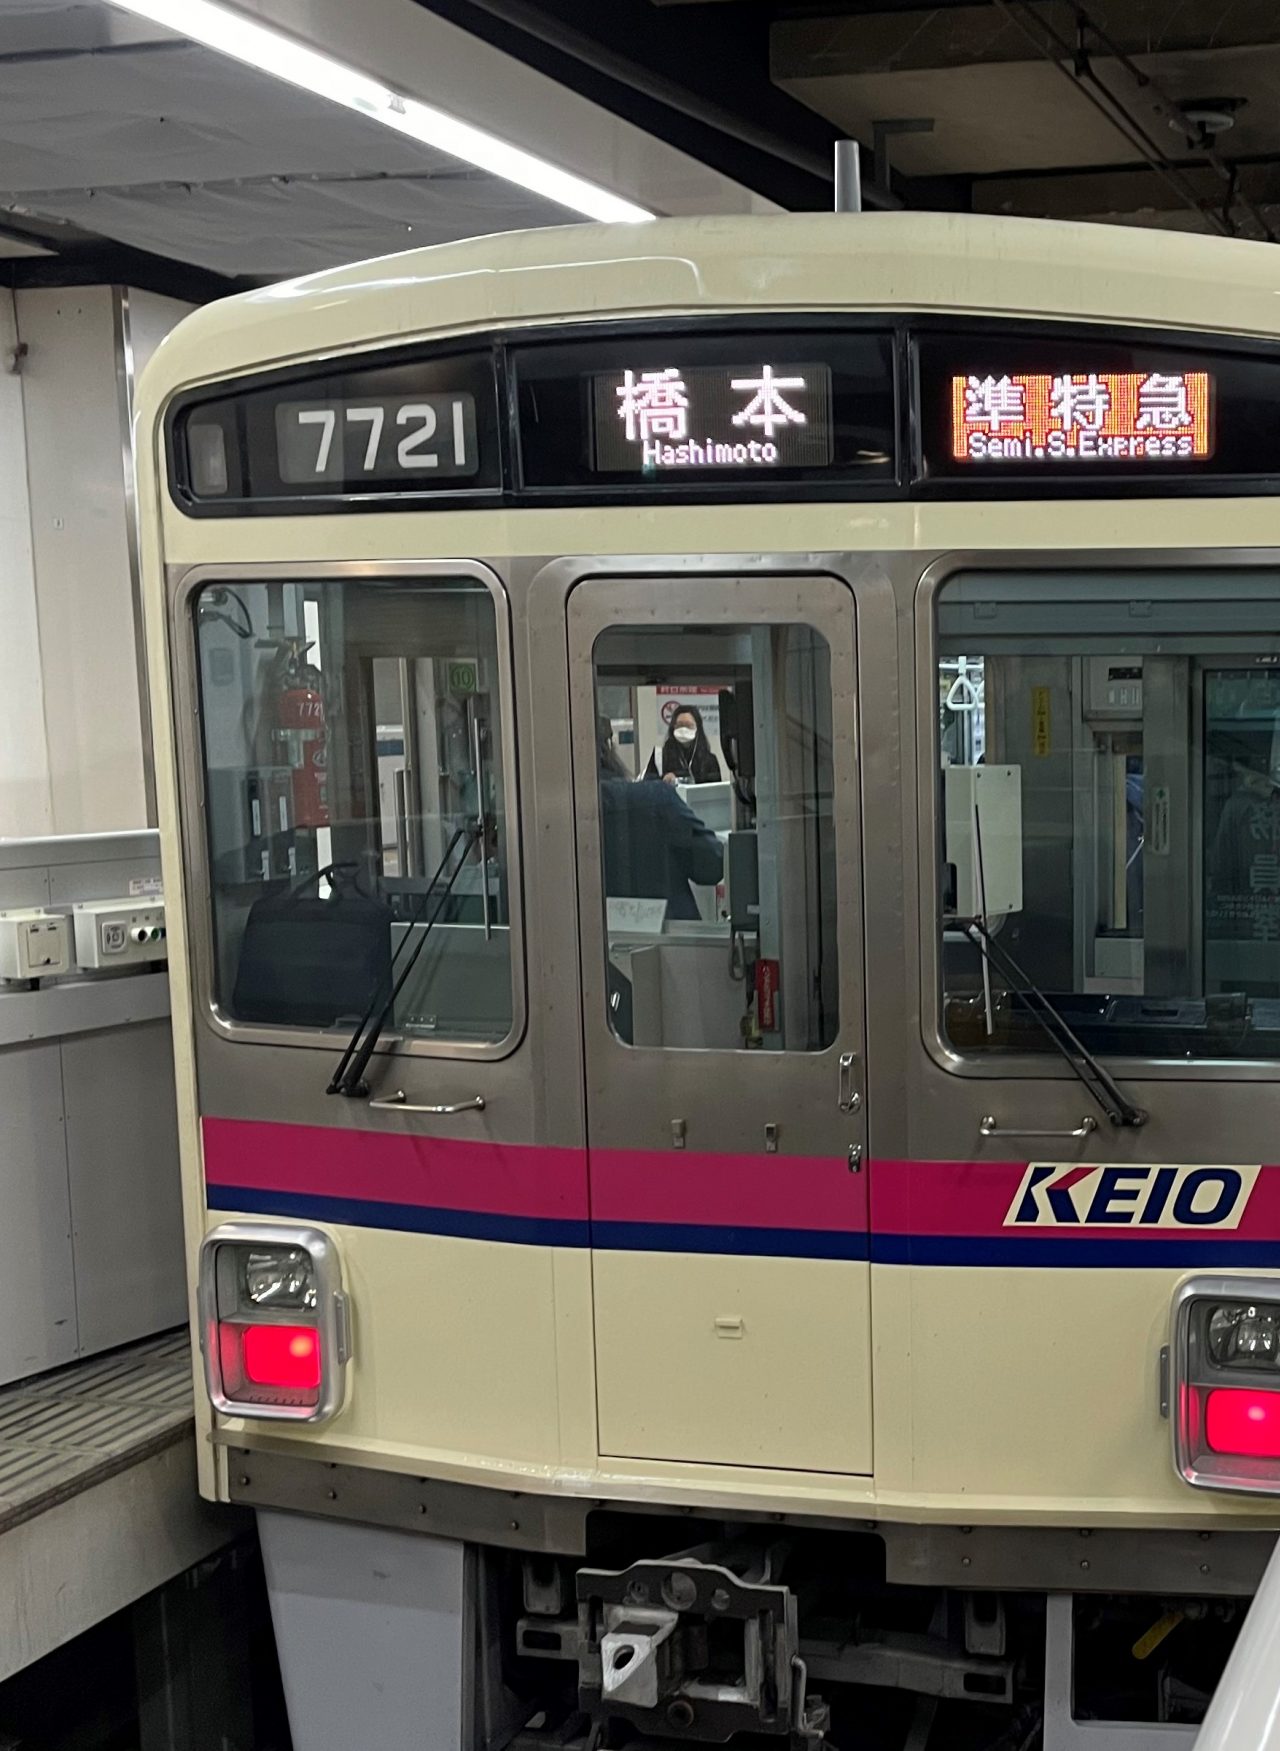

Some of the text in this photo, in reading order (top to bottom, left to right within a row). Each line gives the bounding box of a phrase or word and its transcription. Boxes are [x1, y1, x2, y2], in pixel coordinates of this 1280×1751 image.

[616, 365, 806, 440] 橋本
[966, 373, 1192, 431] 準特急
[299, 401, 466, 473] 7721
[642, 438, 777, 464] Hashimoto
[1015, 1166, 1243, 1225] KEIO
